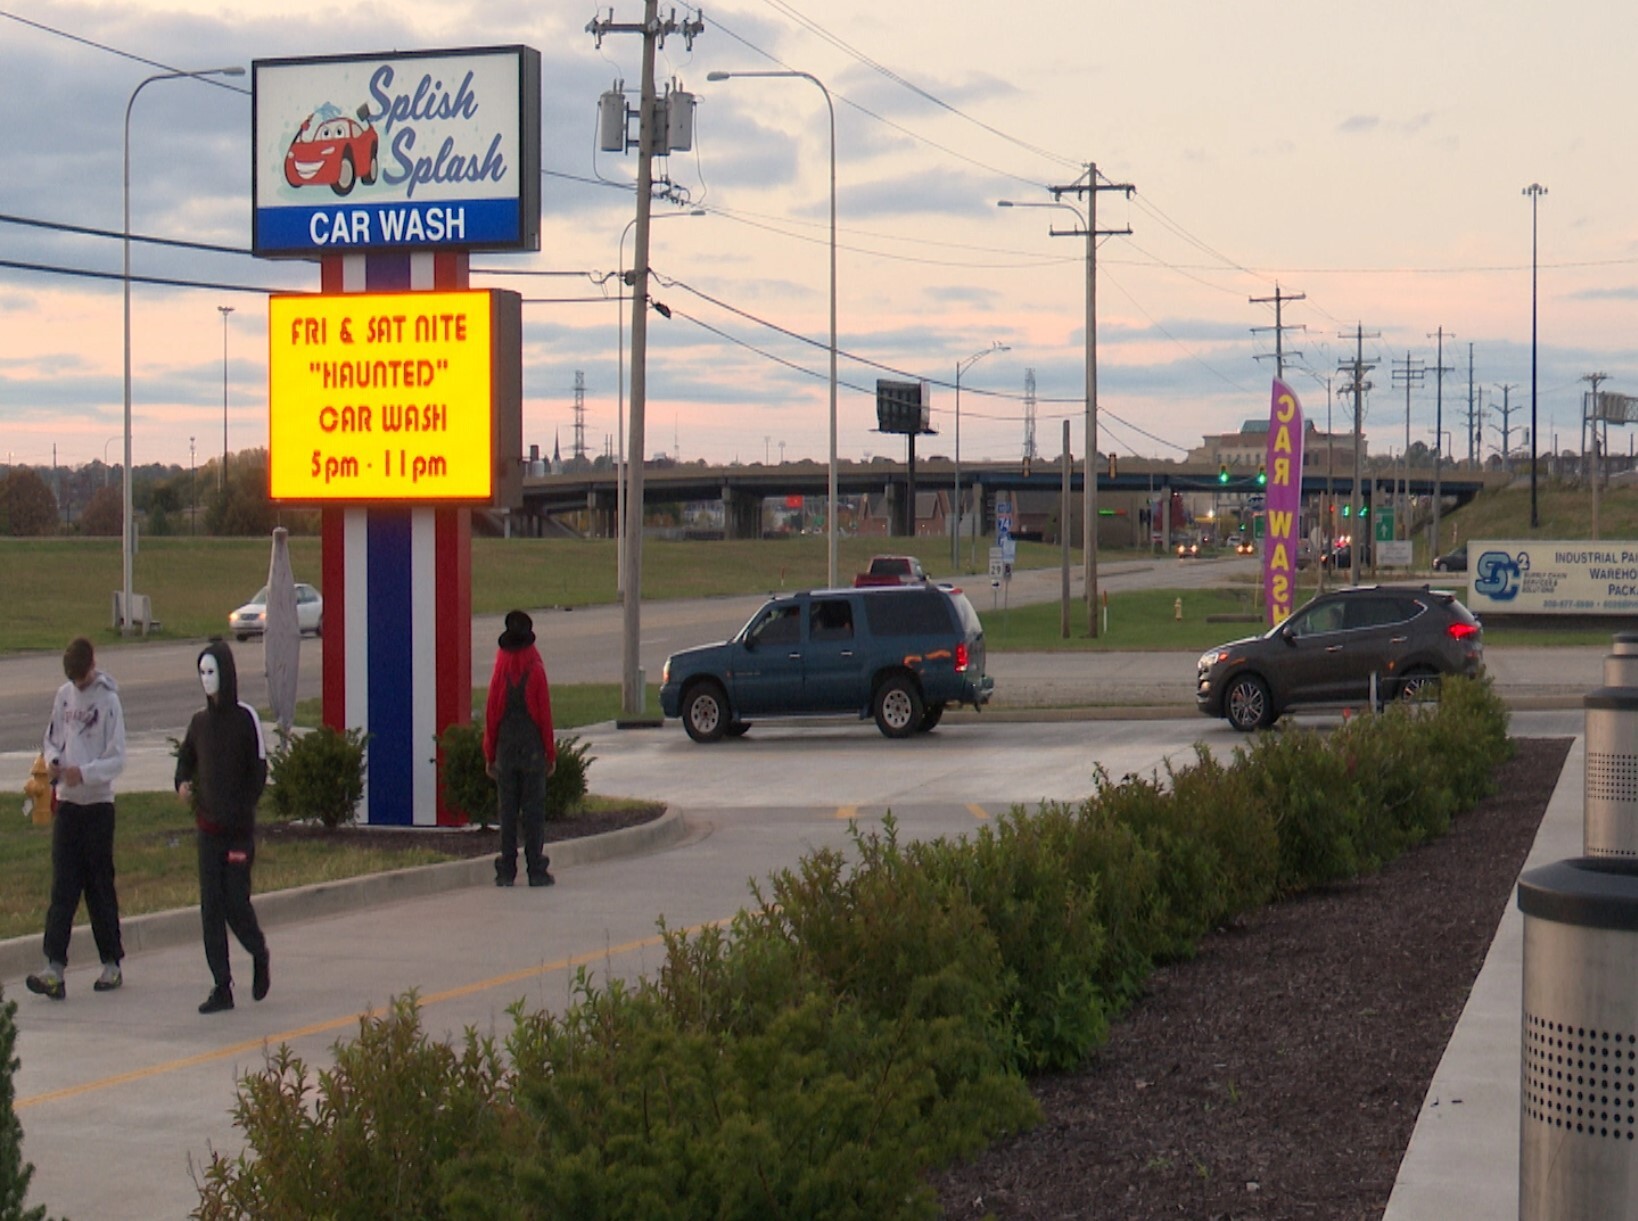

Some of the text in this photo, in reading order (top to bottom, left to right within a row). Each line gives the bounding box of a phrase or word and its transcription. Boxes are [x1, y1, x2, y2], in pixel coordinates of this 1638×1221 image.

[368, 64, 479, 134] Splish
[382, 126, 508, 199] Splash
[309, 206, 466, 245] CAR WASH
[291, 313, 467, 345] FRI & SAT NITE
[309, 358, 449, 389] "HAUNTED"
[319, 404, 447, 432] CAR WASH
[311, 449, 359, 484] 5pm
[1555, 551, 1618, 564] INDUSTRIAL
[1608, 583, 1638, 596] PACK
